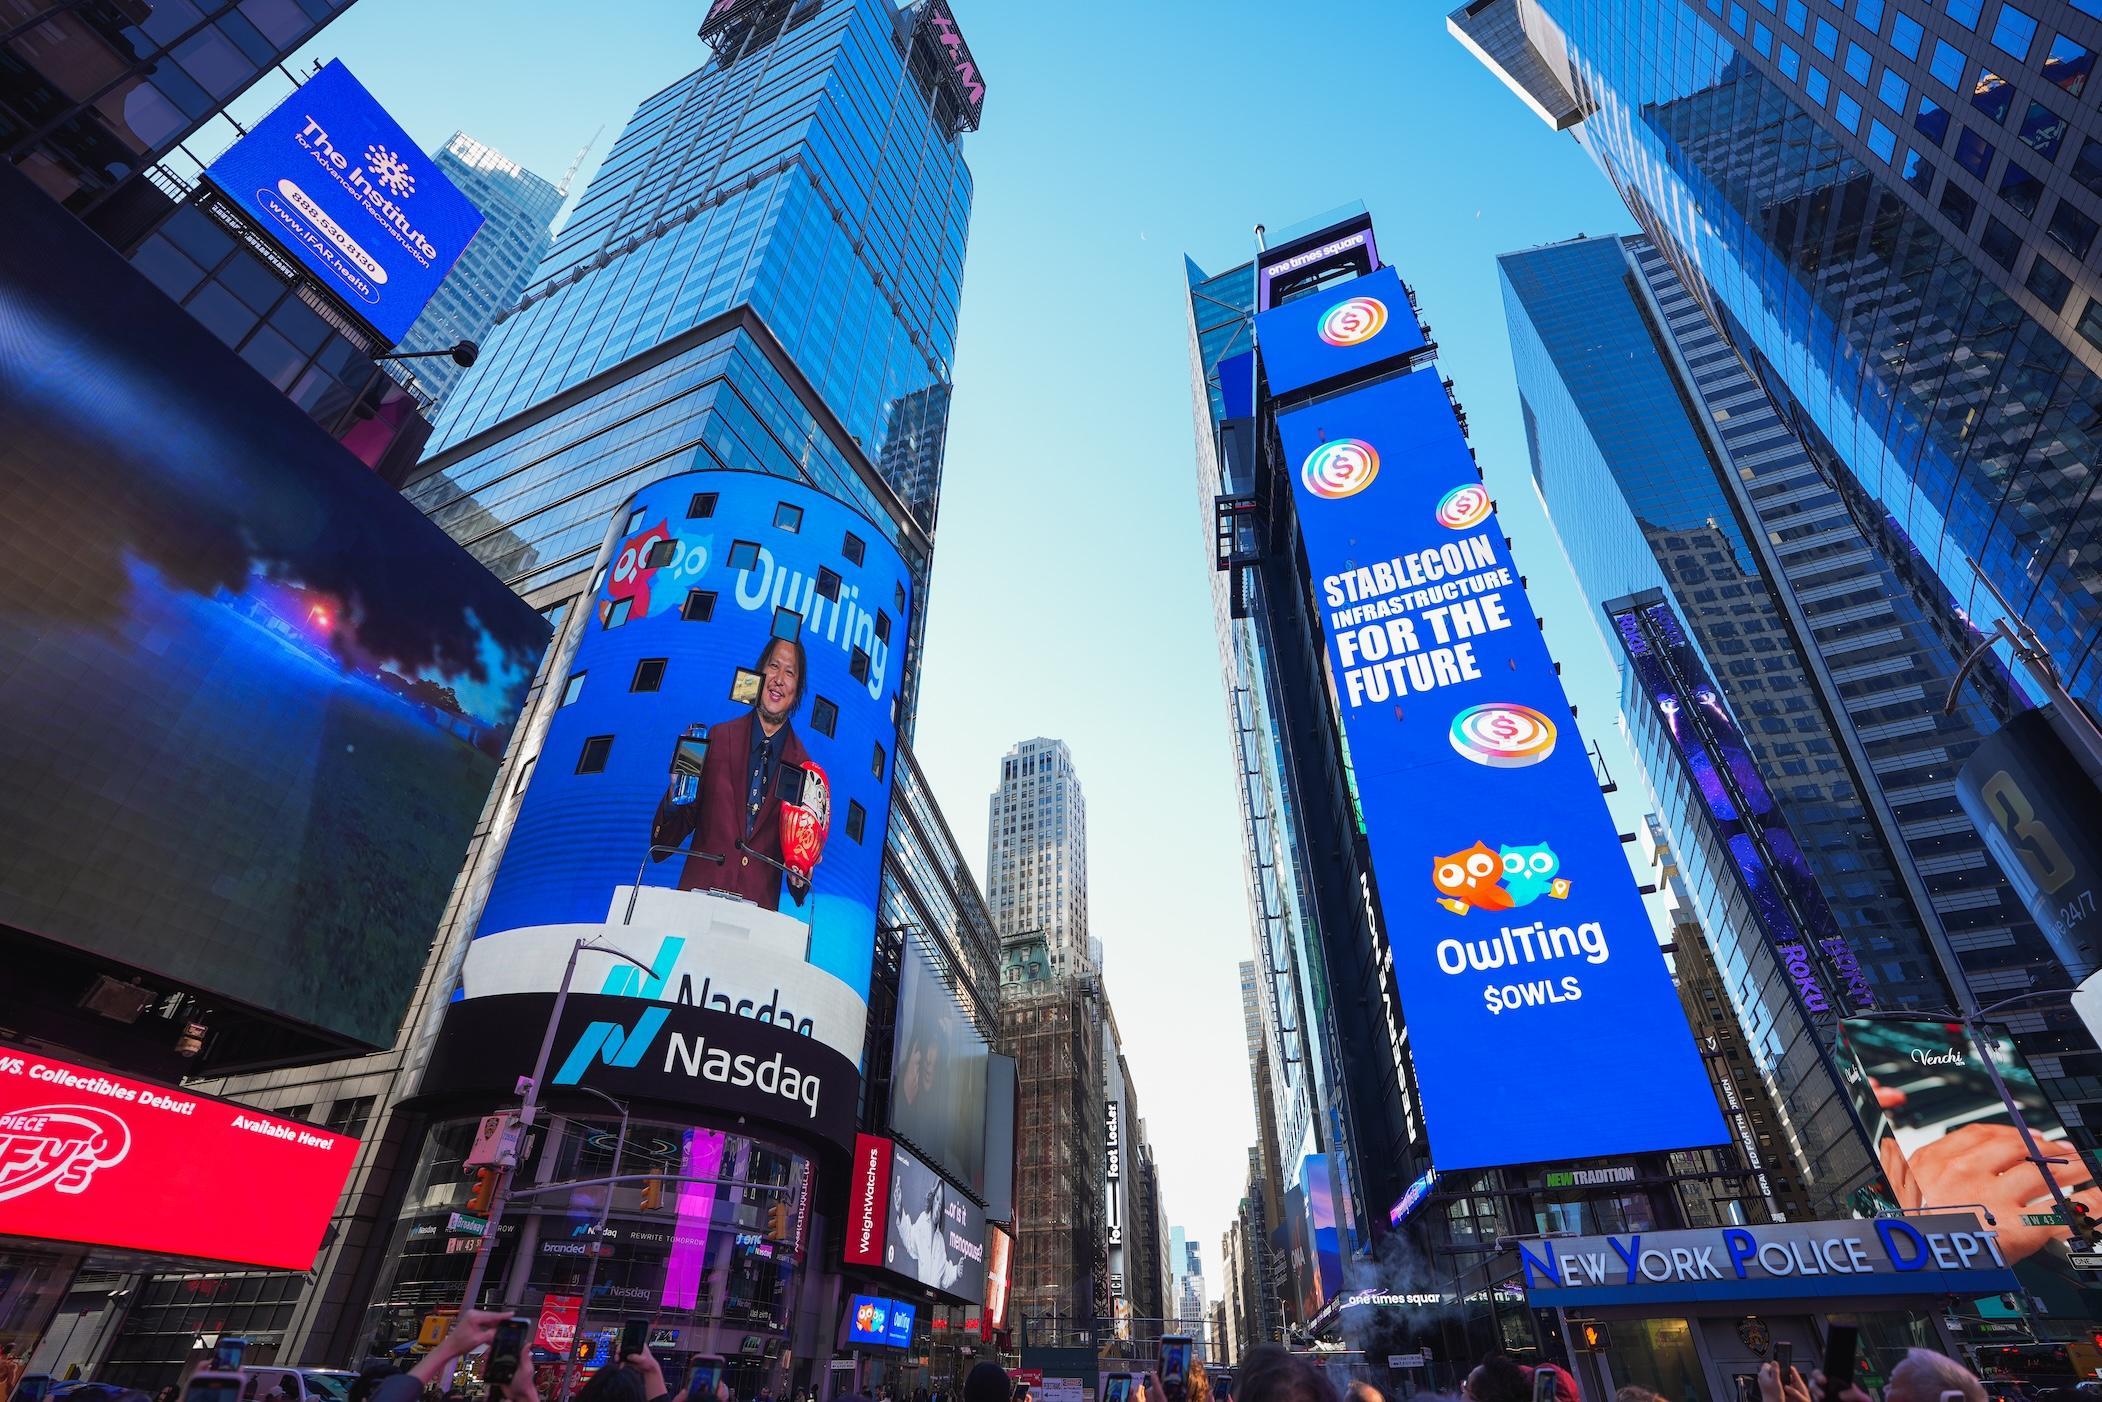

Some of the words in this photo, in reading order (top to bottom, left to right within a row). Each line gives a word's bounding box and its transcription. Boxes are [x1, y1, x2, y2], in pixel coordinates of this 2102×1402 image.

[295, 132, 312, 149] for
[310, 150, 362, 201] Advanced
[361, 200, 430, 269] Reconstruction
[303, 115, 348, 169] The
[348, 167, 437, 260] Institute
[269, 201, 369, 295] www.IFAR.health
[292, 192, 375, 272] 888.530.8130
[1269, 262, 1289, 276] one
[1290, 250, 1323, 267] times
[1323, 234, 1364, 255] square
[1323, 534, 1497, 607] STABLECOIN
[1331, 567, 1513, 629] INFRASTRUCTURE
[1336, 617, 1420, 668] FOR
[1422, 593, 1512, 645] THE
[1344, 642, 1482, 708] FUTURE
[1360, 872, 1383, 966] NOW
[2059, 890, 2097, 929] 24/7
[1436, 921, 1610, 975] OwlTing
[1483, 976, 1582, 1015] $OWLS
[1778, 945, 1830, 1013] ROKU
[663, 1032, 820, 1119] Nasdaq
[1378, 965, 1417, 1145] RESERVE
[1911, 1048, 1962, 1066] Venchi
[29, 1064, 137, 1101] Collectibles
[138, 1090, 196, 1116] Debut!
[231, 1115, 297, 1141] Available
[297, 1131, 335, 1151] Here!
[1105, 1104, 1118, 1147] Locker
[1107, 1149, 1119, 1177] Foot
[859, 1148, 878, 1253] WeightWatchers
[2030, 1216, 2041, 1226] W
[2043, 1216, 2055, 1225] 43
[456, 1240, 464, 1251] W
[464, 1239, 475, 1251] 43
[457, 1216, 485, 1235] Broadway
[587, 1226, 618, 1238] Ndaq
[630, 1231, 663, 1242] REWRITE
[665, 1235, 706, 1246] TOMORROW
[543, 1243, 586, 1254] branded
[949, 1231, 983, 1264] menopause?
[610, 1286, 651, 1301] Nasdaq
[1349, 1295, 1370, 1305] one
[1371, 1294, 1405, 1305] times
[1406, 1294, 1441, 1306] squar
